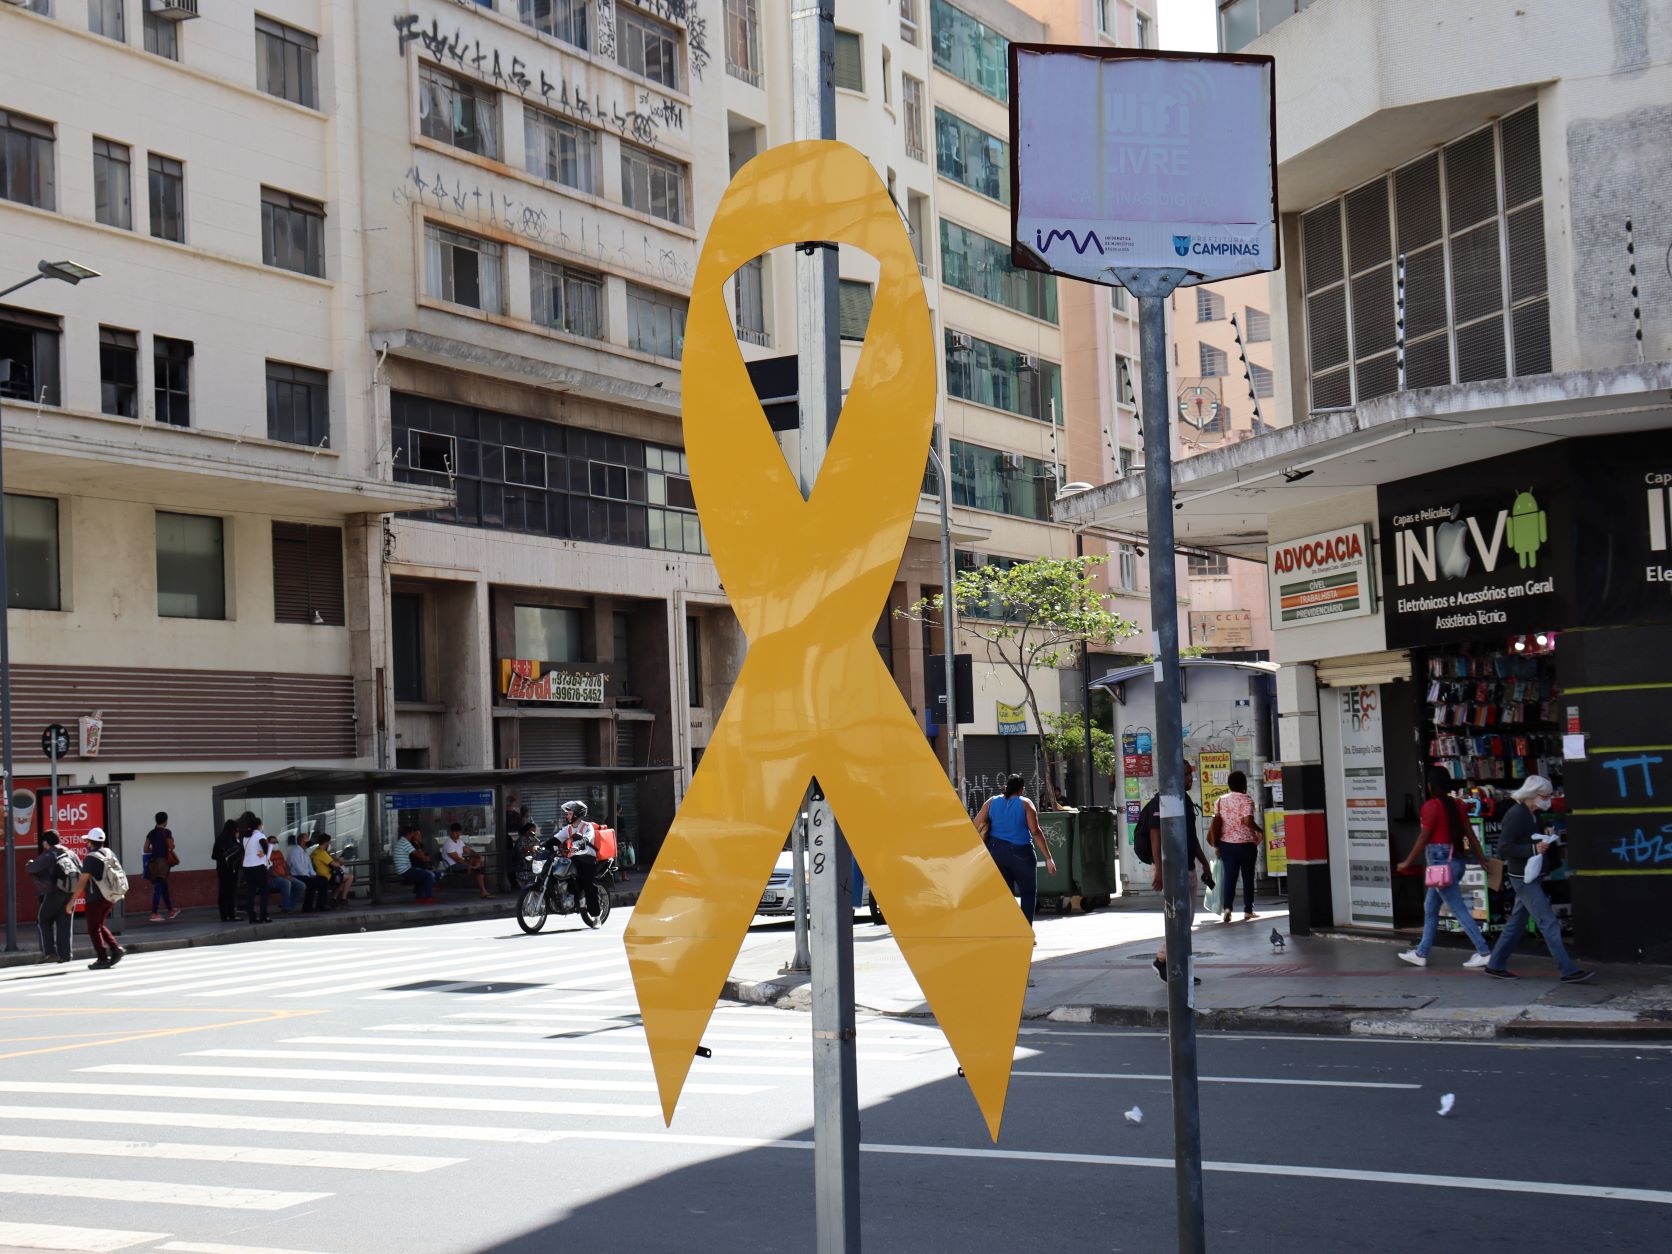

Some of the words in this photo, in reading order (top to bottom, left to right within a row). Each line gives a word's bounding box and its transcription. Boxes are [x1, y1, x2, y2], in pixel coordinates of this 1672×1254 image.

[1192, 242, 1260, 256] CAMPINAS
[1392, 513, 1414, 527] Capas
[1420, 506, 1451, 521] Películas
[1647, 487, 1672, 551] I
[1274, 533, 1363, 575] ADVOCACIA
[1309, 579, 1326, 591] CÍVEL
[1299, 590, 1338, 604] TRABALHISTA
[1398, 595, 1448, 613] Eletrônicos
[1450, 597, 1456, 607] e
[1457, 586, 1506, 606] Acessórios
[1508, 586, 1525, 598] em
[1525, 576, 1554, 595] Geral
[1296, 603, 1344, 619] PREVIDENCIÁRIO
[1435, 613, 1477, 630] Assistência
[1477, 609, 1507, 624] Técnica
[1204, 801, 1211, 813] 3
